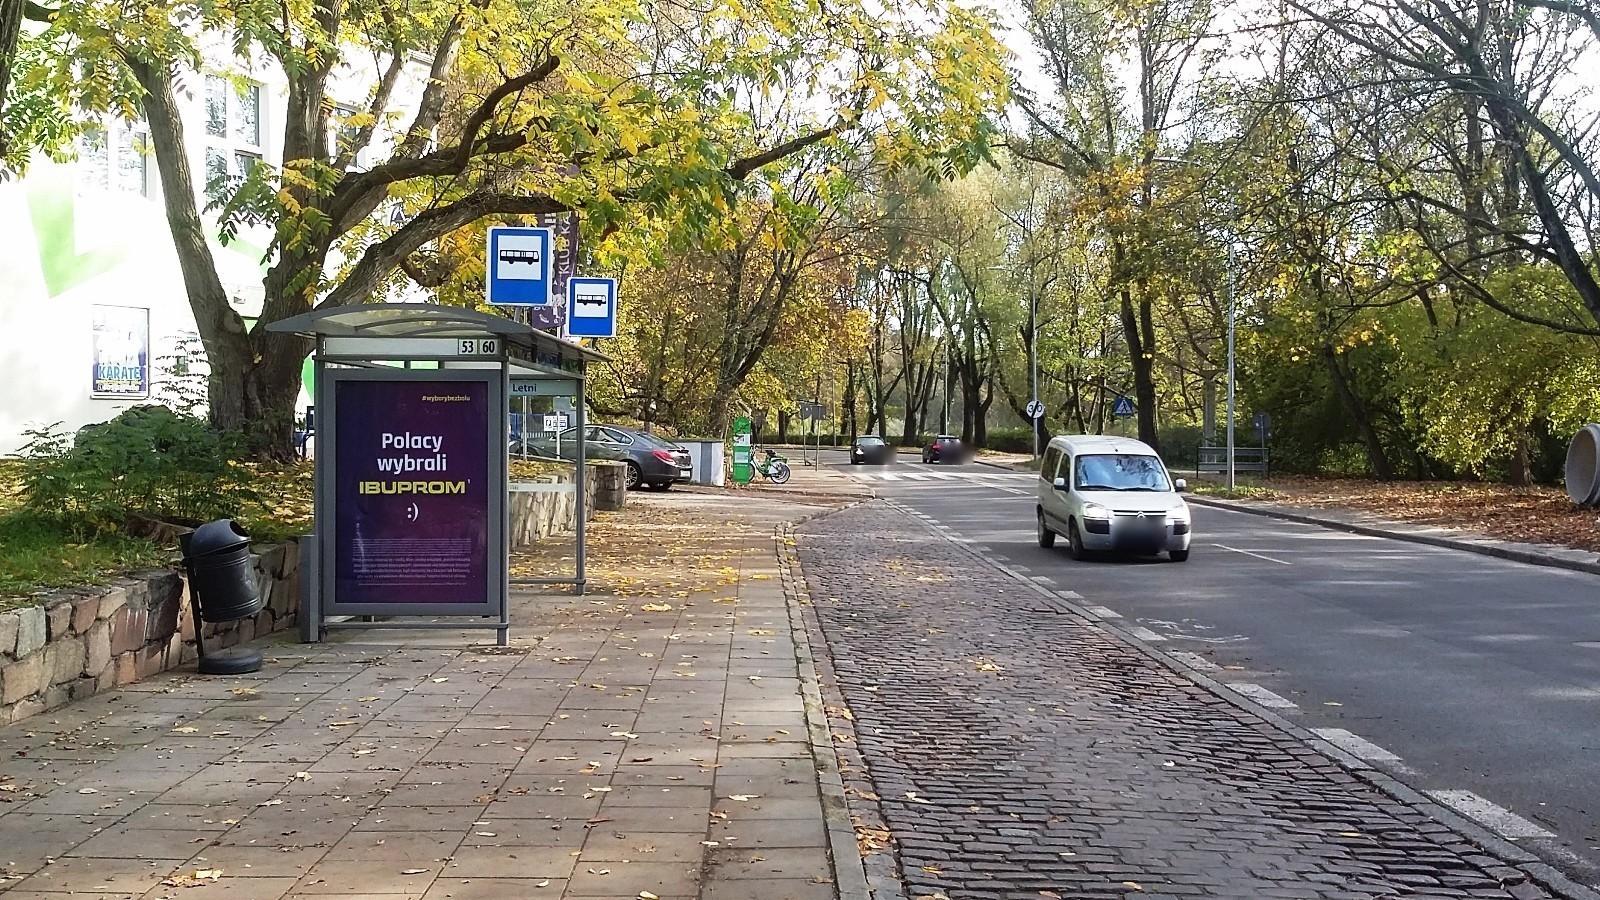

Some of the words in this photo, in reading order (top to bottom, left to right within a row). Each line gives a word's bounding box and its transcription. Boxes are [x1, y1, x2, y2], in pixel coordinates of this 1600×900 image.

[461, 340, 474, 353] 53
[482, 340, 495, 353] 60
[99, 366, 140, 379] KARATE
[512, 383, 537, 393] Letni
[1028, 404, 1043, 413] 30
[381, 431, 443, 453] Polacy
[377, 453, 447, 475] wybrali
[359, 481, 466, 495] IBUPROM
